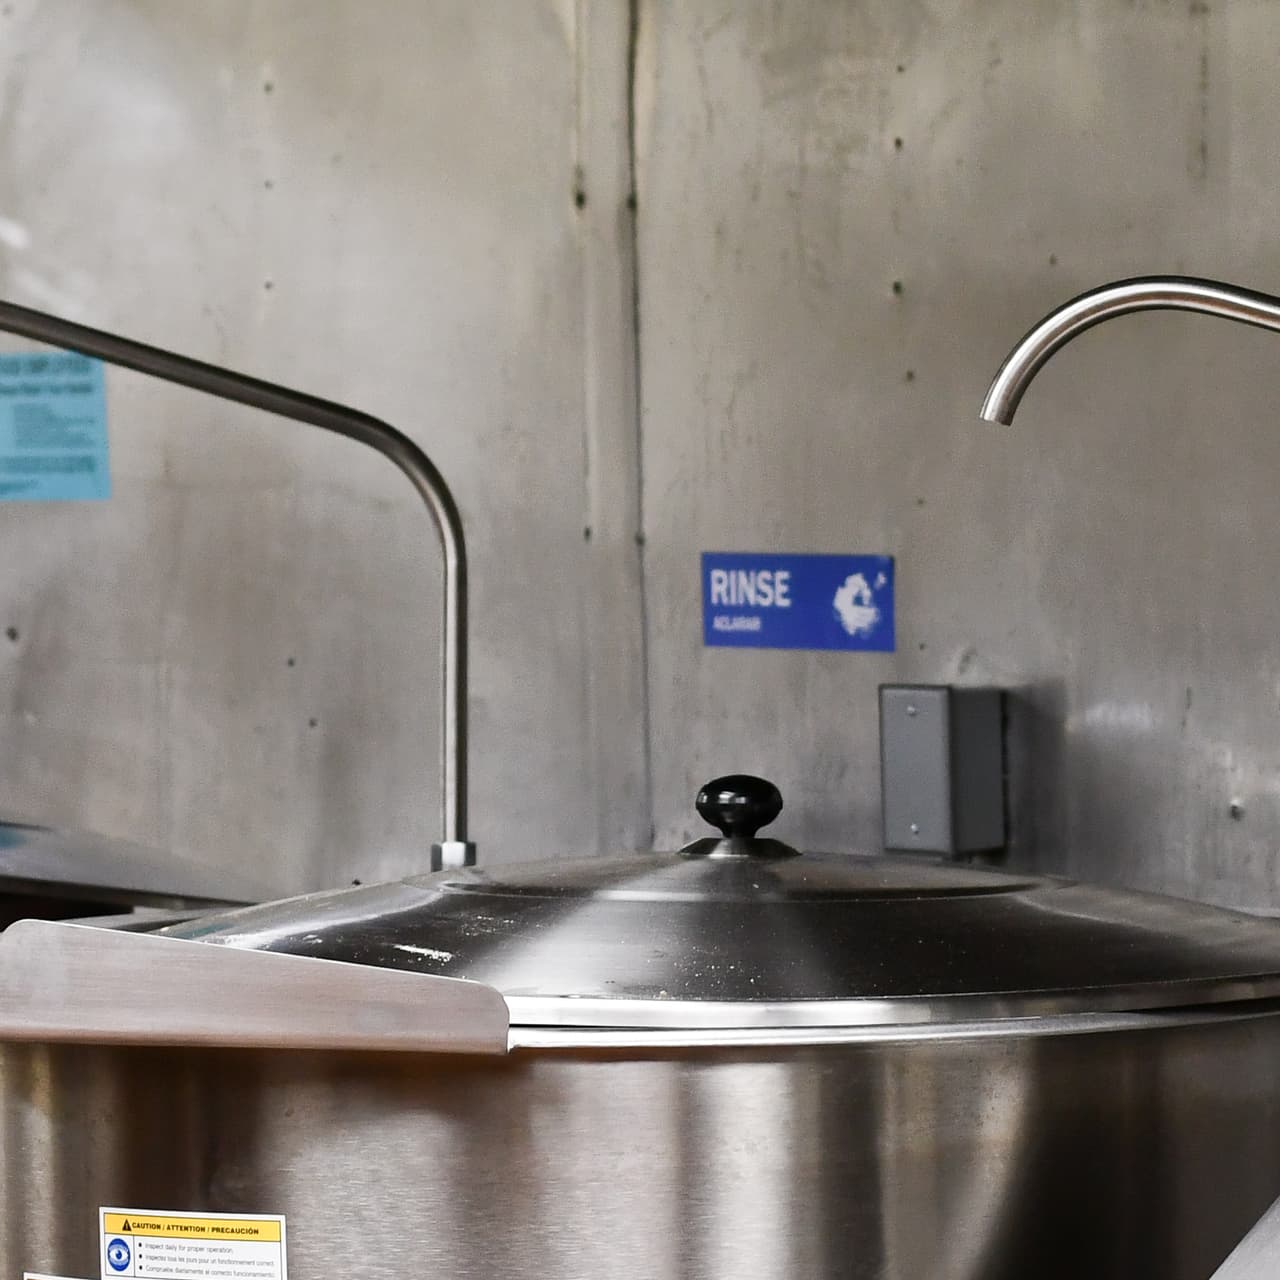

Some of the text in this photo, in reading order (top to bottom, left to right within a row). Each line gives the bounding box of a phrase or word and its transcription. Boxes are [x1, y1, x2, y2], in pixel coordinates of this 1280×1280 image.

[710, 569, 792, 607] RINSE
[166, 1224, 205, 1232] ATTENTION
[211, 1226, 258, 1234] PRECAUCIÓN
